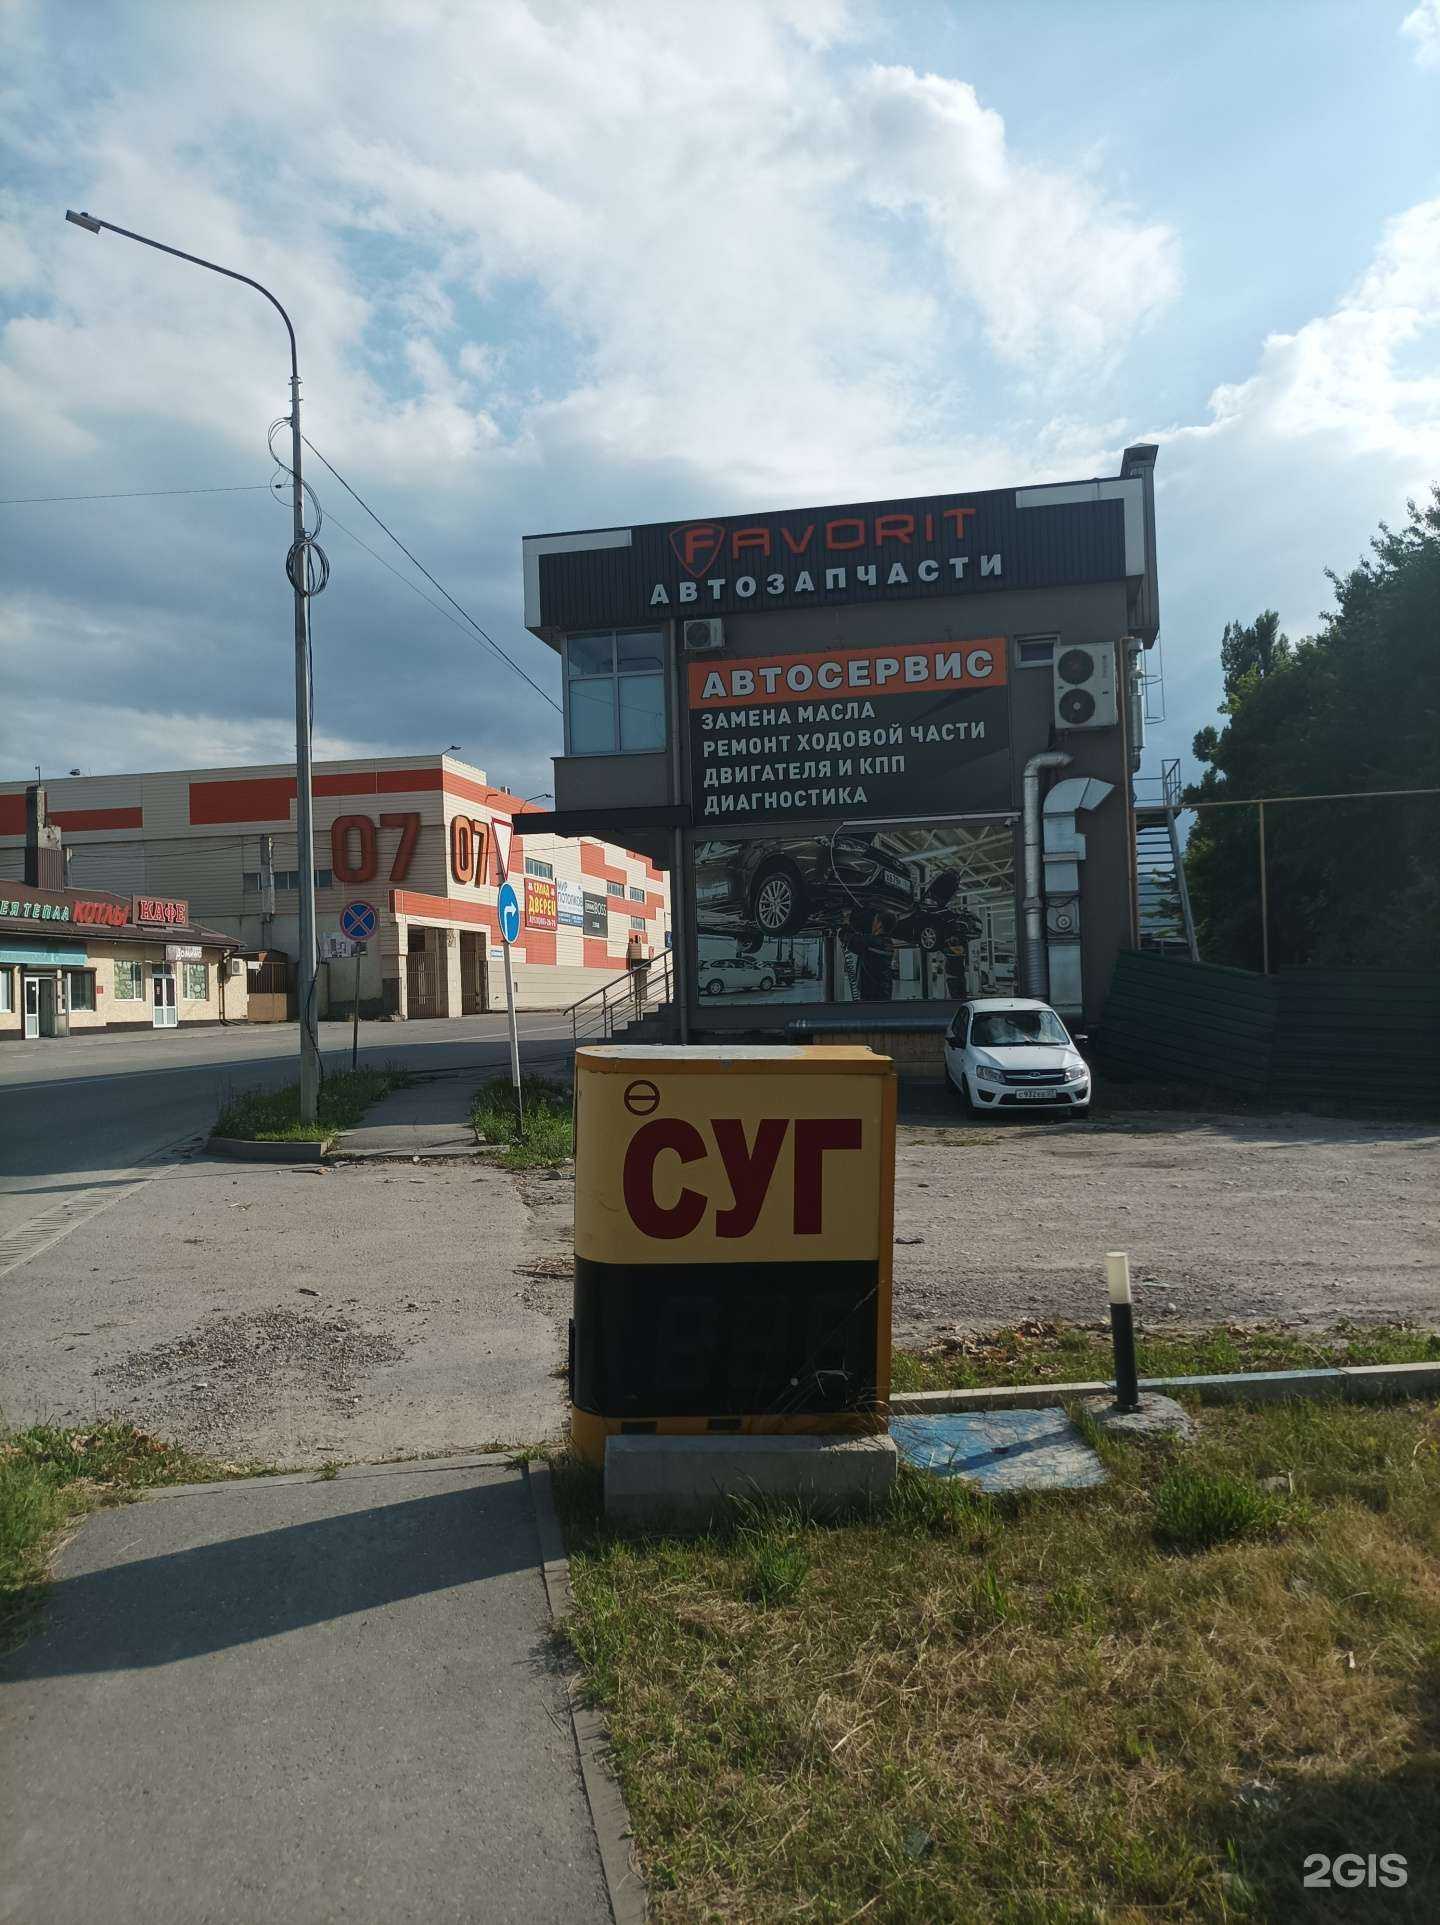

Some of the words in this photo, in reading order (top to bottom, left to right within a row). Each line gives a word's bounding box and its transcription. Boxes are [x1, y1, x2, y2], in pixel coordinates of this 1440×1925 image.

[684, 507, 977, 564] FAVORIT
[649, 553, 1003, 606] АВТОЗАПЧАСТИ
[701, 649, 994, 699] АВТОСЕРВИС
[701, 706, 792, 731] ЗАМЕНА
[798, 701, 876, 724] МАСЛА
[703, 734, 791, 758] РЕМОНТ
[797, 722, 904, 752] ХОДОВОЙ
[910, 720, 986, 743] ЧАСТИ
[703, 760, 832, 788] ДВИГАТЕЛЯ
[838, 758, 853, 777] И
[860, 755, 906, 775] КПП
[704, 785, 868, 816] ДИАГНОСТИКА
[331, 812, 421, 883] 07
[450, 814, 490, 888] 07
[24, 902, 70, 921] ТЕПЛА
[140, 900, 186, 924] КАФЕ
[622, 1117, 863, 1240] СУГ
